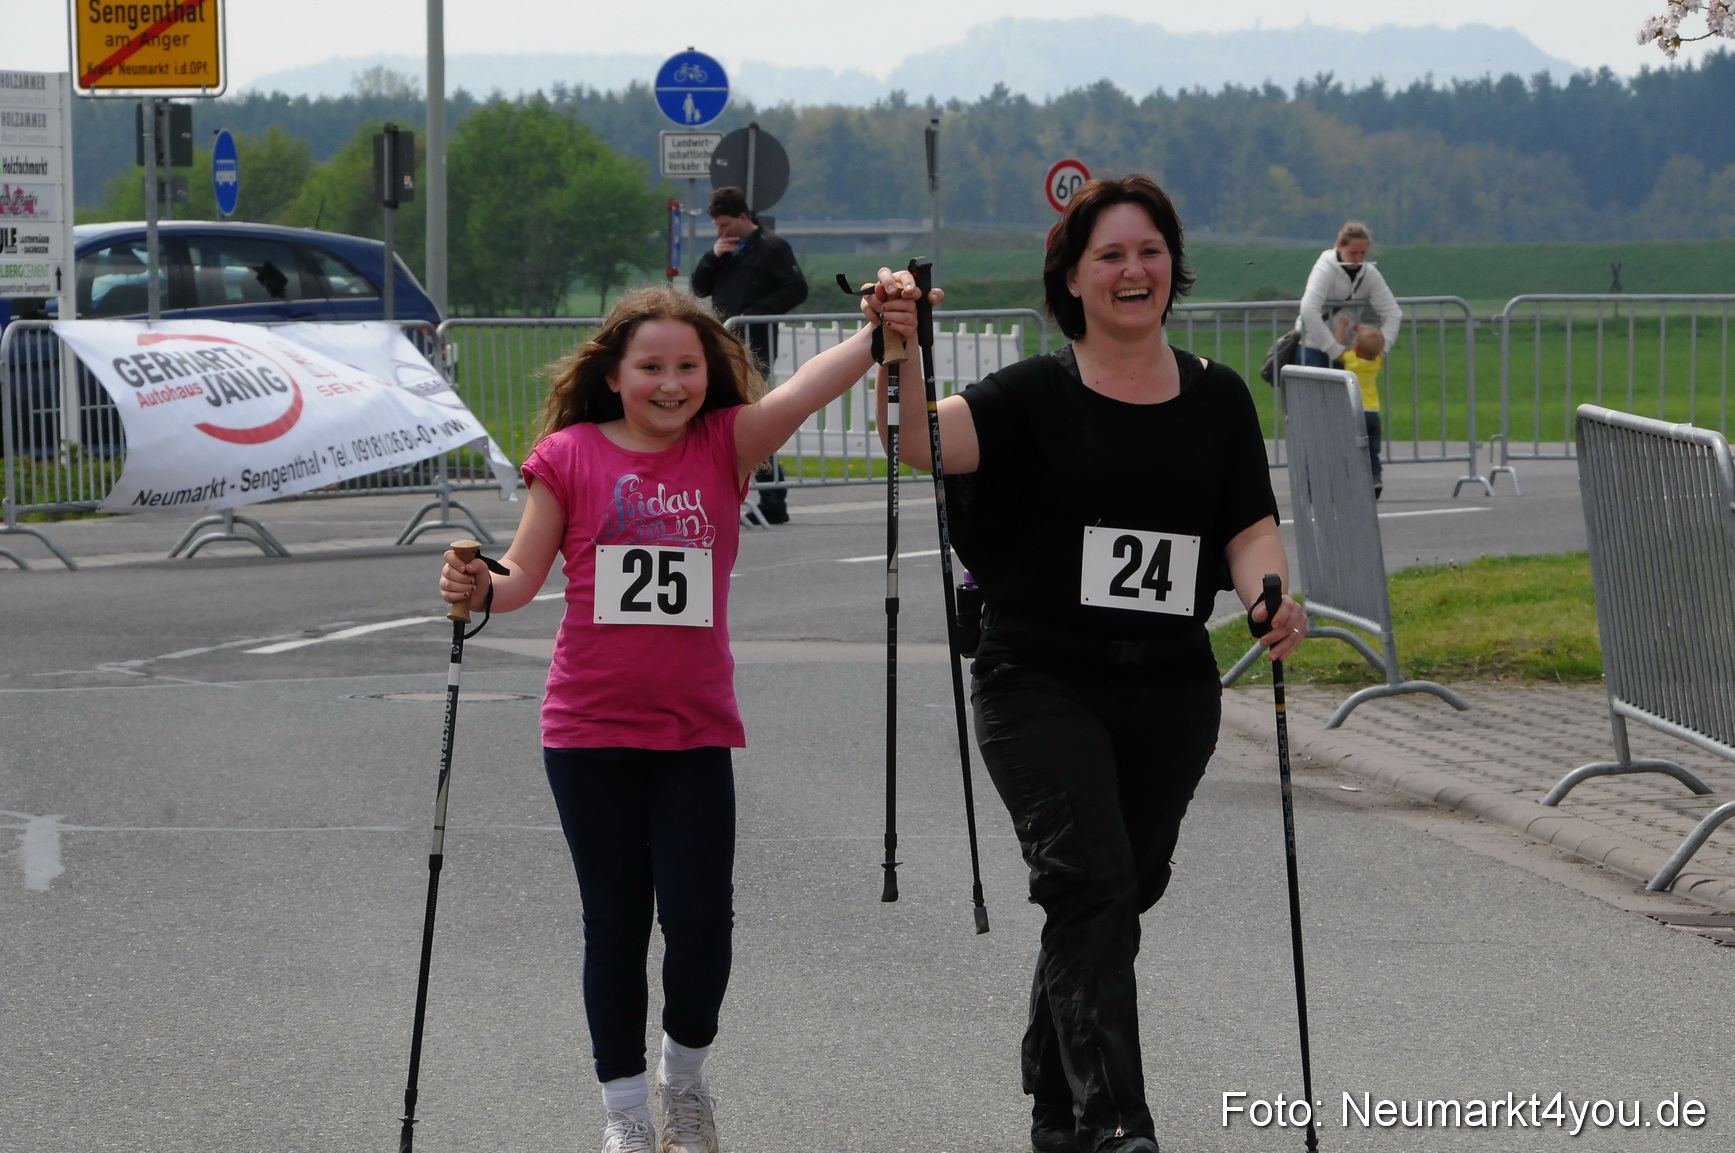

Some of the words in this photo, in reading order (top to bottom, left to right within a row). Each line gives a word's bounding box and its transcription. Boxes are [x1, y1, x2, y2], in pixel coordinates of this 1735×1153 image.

[89, 0, 205, 30] Sengenthal
[105, 35, 130, 47] am
[139, 33, 189, 50] Anger
[118, 62, 169, 75] Neumarkt
[1, 111, 47, 128] HOLZAMMER
[2, 155, 48, 175] Holzfachmarkt
[1056, 175, 1083, 200] 60
[112, 347, 245, 387] GERHART
[135, 382, 204, 408] Autohaus
[201, 366, 288, 407] JÄNIG
[932, 422, 943, 476] NORDIC
[132, 477, 226, 507] Neumarkt
[241, 451, 321, 492] Sengenthal
[328, 445, 353, 468] Tel.
[620, 549, 688, 615] 25
[1109, 534, 1173, 602] 24
